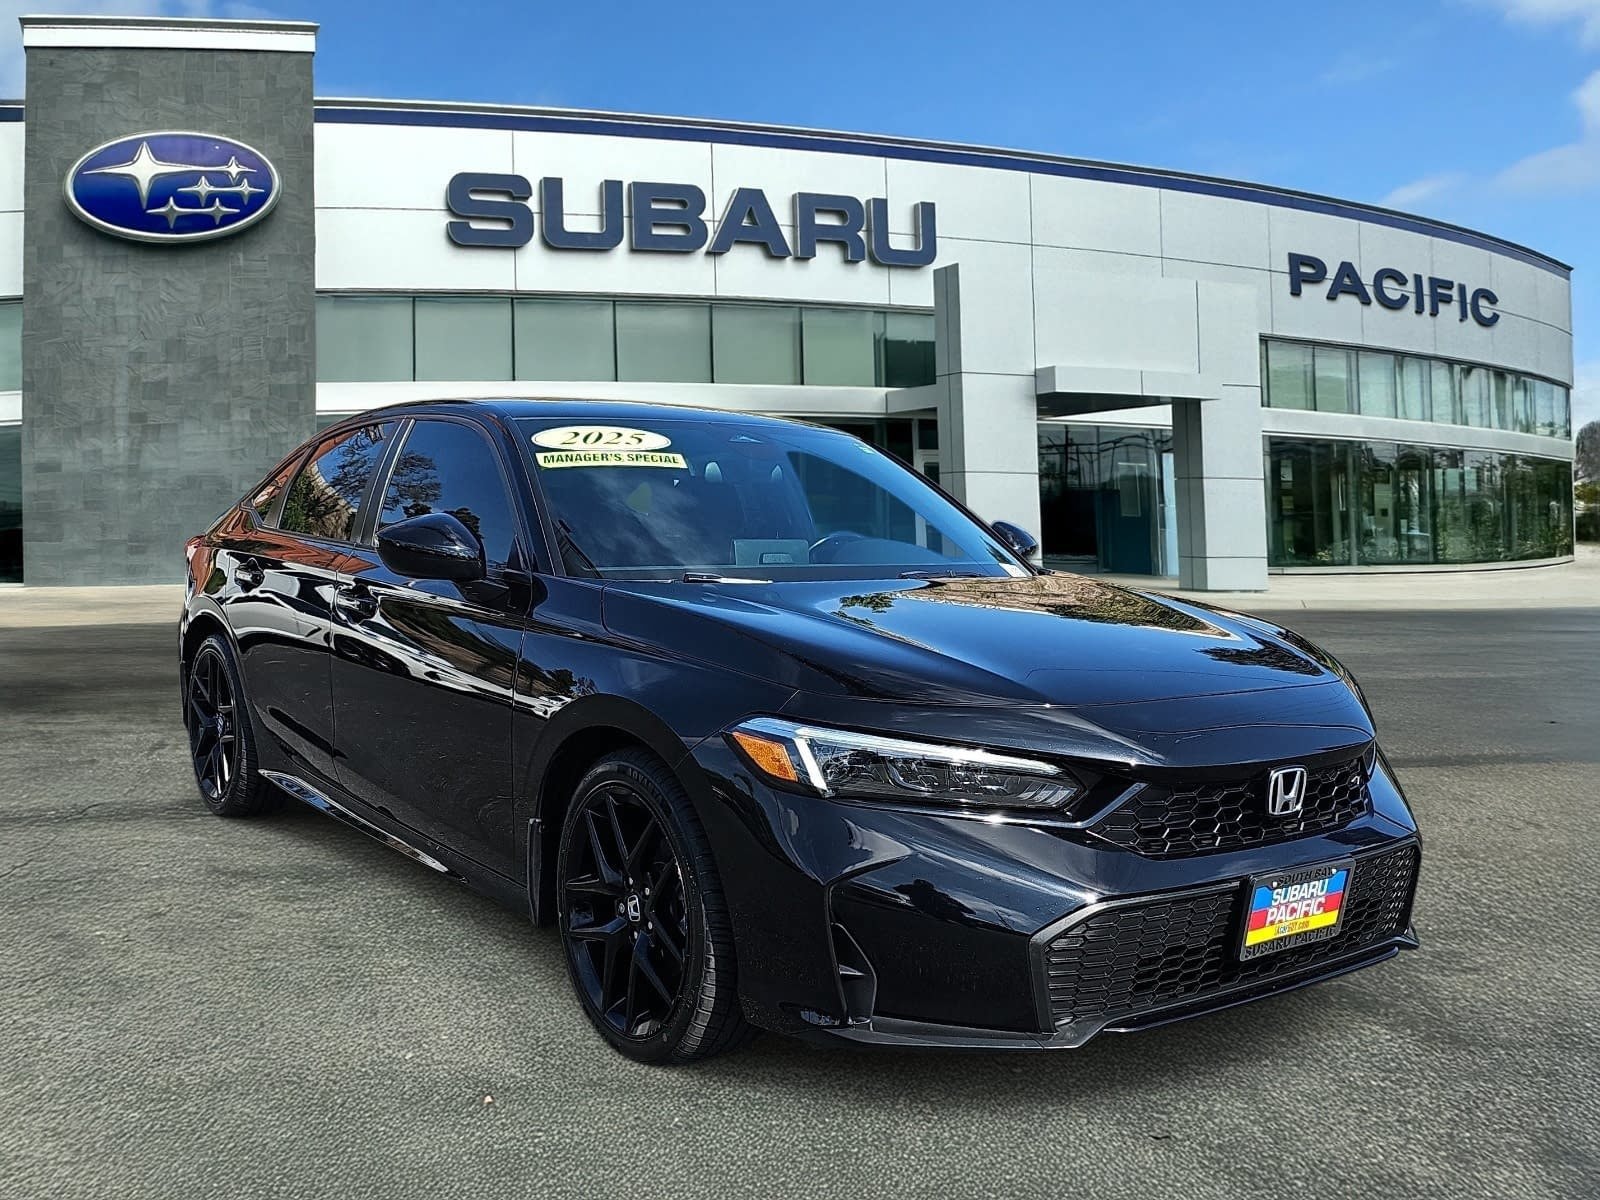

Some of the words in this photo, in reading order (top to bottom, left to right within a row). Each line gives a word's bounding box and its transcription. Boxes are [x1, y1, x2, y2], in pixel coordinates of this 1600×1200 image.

[447, 171, 937, 267] SUBARU
[1288, 252, 1500, 327] PACIFIC
[560, 431, 646, 446] 2025
[543, 452, 622, 464] MANAGER'S
[627, 453, 680, 464] SPECIAL
[1278, 869, 1313, 886] SOUTH
[1272, 879, 1328, 905] SUBARU
[1265, 897, 1326, 926] PACIFIC
[1244, 935, 1291, 959] SUBARU
[1294, 926, 1337, 947] PACIFIC
